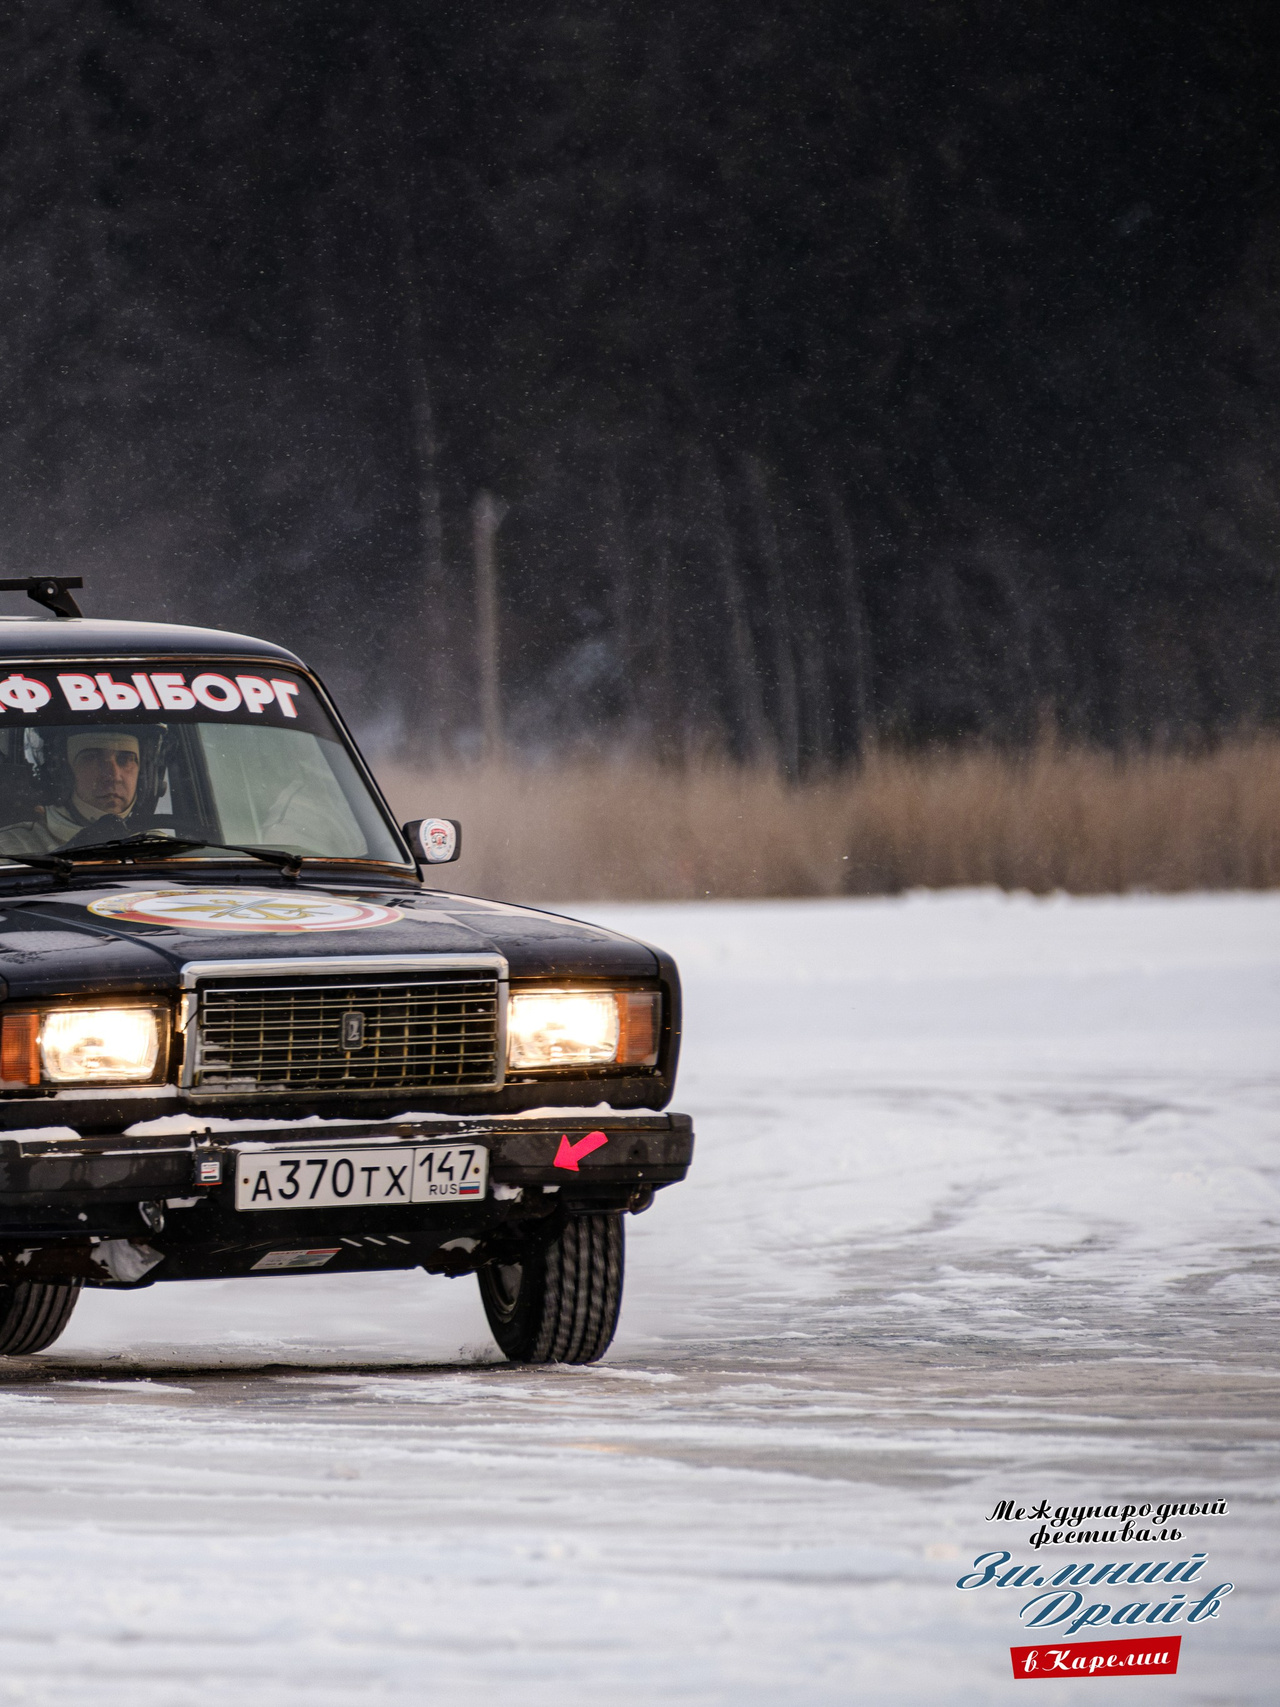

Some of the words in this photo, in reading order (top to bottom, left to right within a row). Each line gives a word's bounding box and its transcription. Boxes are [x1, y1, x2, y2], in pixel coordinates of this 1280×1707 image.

[57, 672, 300, 718] ВЫБОРГ
[251, 1158, 408, 1202] А370ТХ
[419, 1150, 476, 1183] 147
[428, 1184, 459, 1195] RUS
